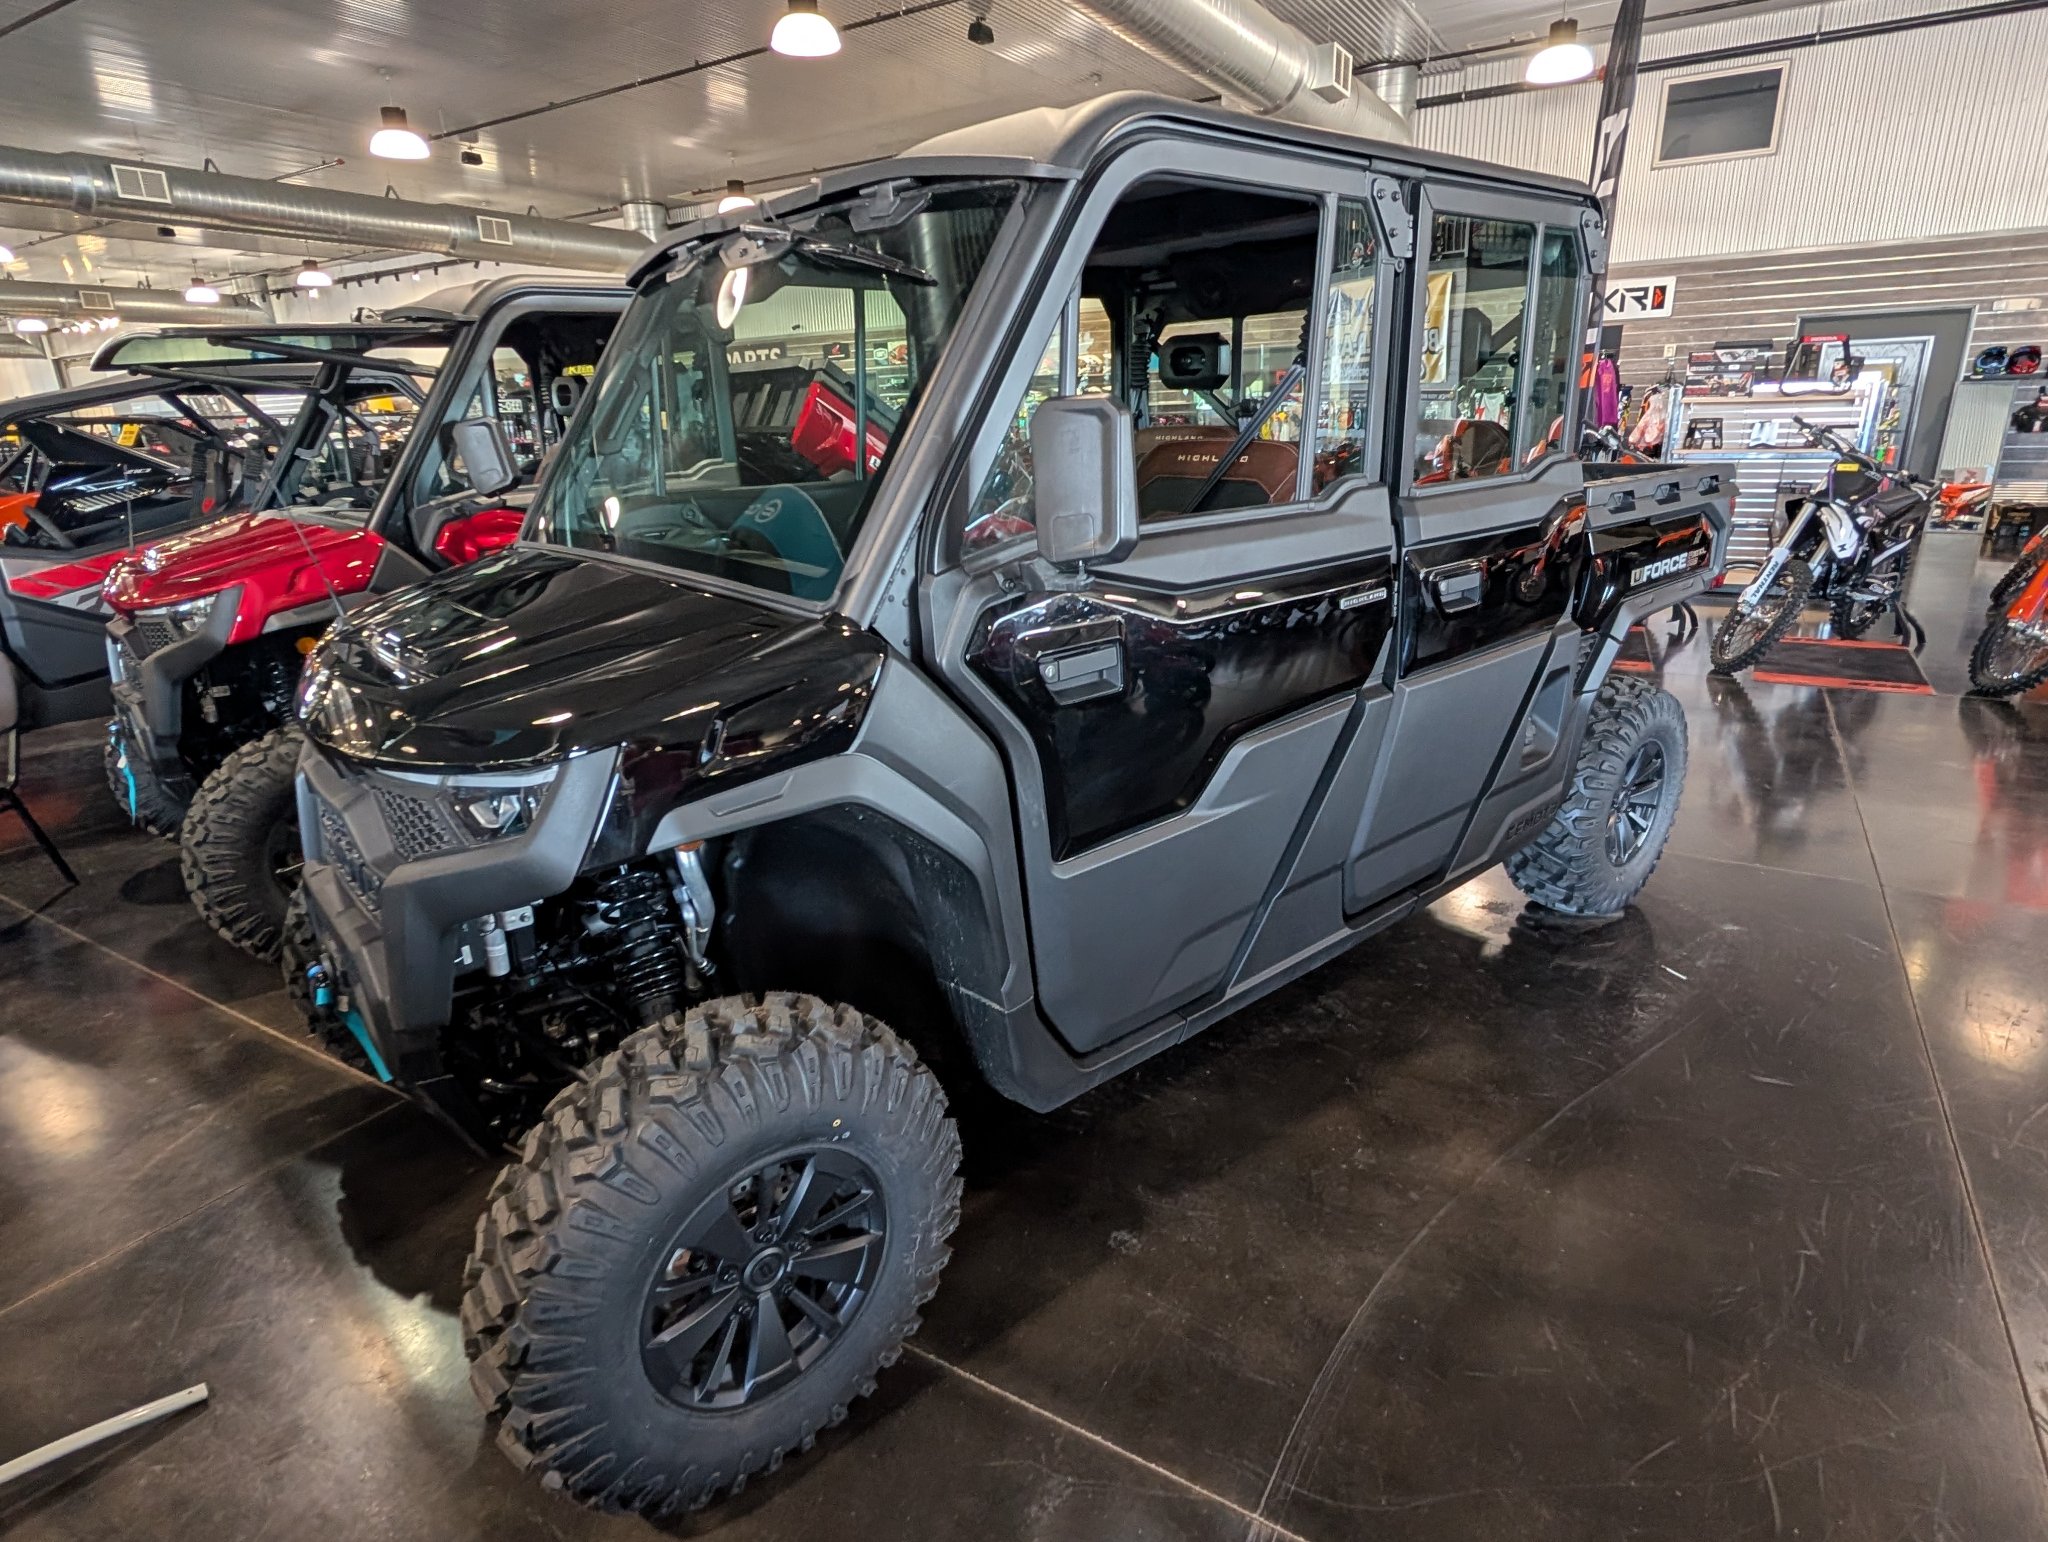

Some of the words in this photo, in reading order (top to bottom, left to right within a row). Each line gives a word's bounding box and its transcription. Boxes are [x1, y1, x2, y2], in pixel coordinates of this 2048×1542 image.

[1593, 286, 1649, 313] XR
[726, 347, 781, 364] ARTS
[1178, 454, 1249, 463] HIGHLD
[1751, 561, 1779, 598] RENTHAL
